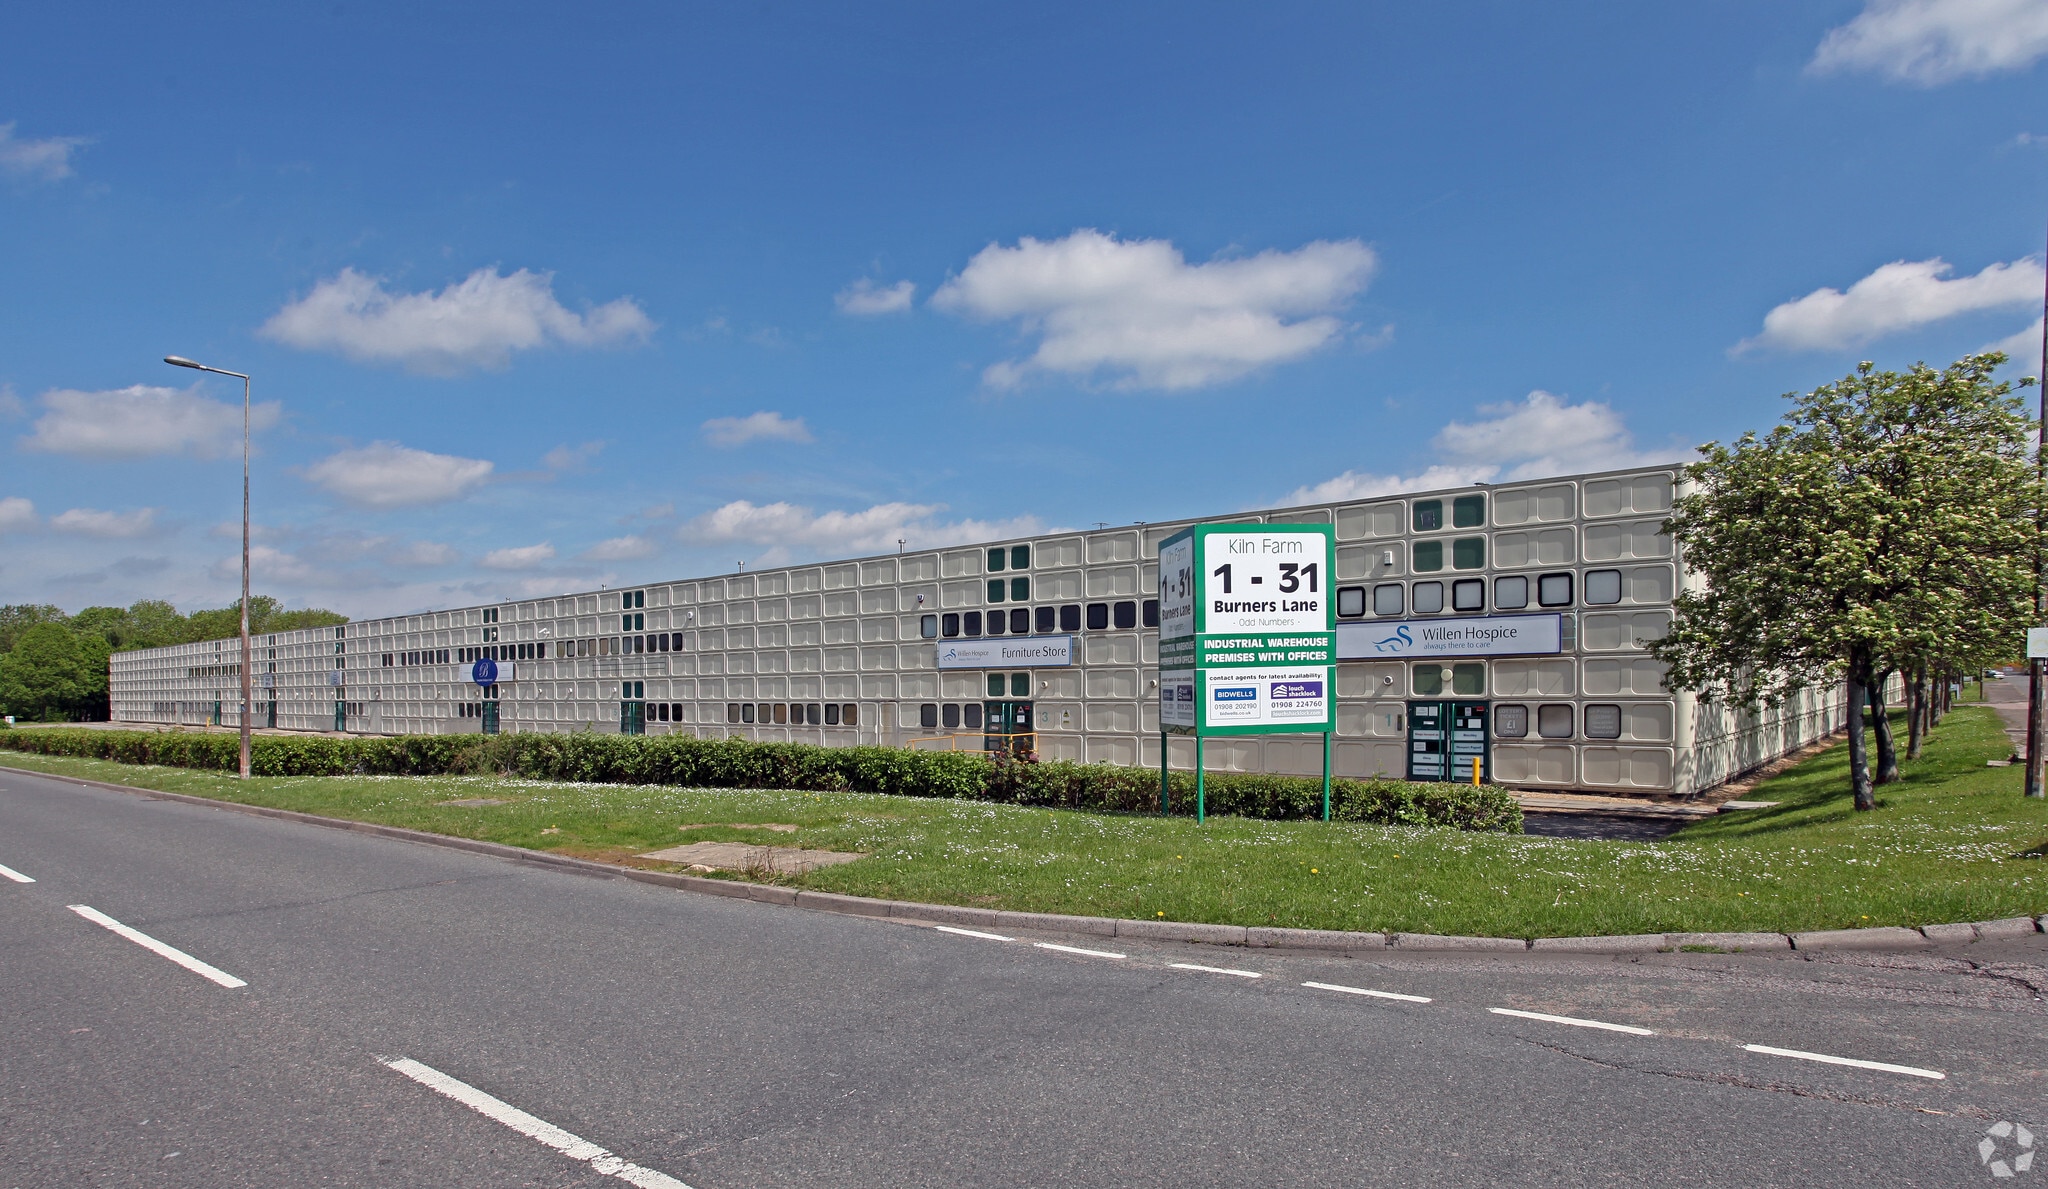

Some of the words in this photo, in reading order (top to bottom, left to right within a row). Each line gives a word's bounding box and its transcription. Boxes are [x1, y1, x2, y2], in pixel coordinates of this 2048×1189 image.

[1229, 539, 1255, 554] Kiln
[1263, 539, 1303, 554] Farm
[1162, 575, 1168, 603] 1
[1179, 567, 1191, 598] 31
[1214, 563, 1232, 594] 1
[1251, 576, 1263, 585] -
[1279, 563, 1318, 594] 31
[1180, 604, 1191, 618] Lane
[1214, 600, 1277, 613] Burners
[1282, 599, 1318, 612] Lane
[1238, 618, 1256, 627] Odd
[1258, 618, 1295, 627] Numbers
[1422, 627, 1462, 641] Willen
[1465, 625, 1518, 643] Hospice
[1204, 638, 1264, 649] INDUSTRIAL
[1267, 637, 1328, 648] WAREHOUSE
[1423, 642, 1447, 651] always
[1448, 641, 1464, 649] there
[1467, 641, 1474, 649] to
[1002, 647, 1041, 659] Furniture
[1043, 646, 1067, 657] Store
[1205, 652, 1256, 663] PREMISES
[1258, 651, 1285, 662] WITH
[1287, 650, 1328, 661] OFFICES
[1288, 672, 1323, 680] availability:
[1217, 690, 1253, 698] BIDWELLS
[1235, 702, 1257, 710] 202190
[1271, 701, 1293, 709] 01908
[1296, 700, 1322, 708] 224760
